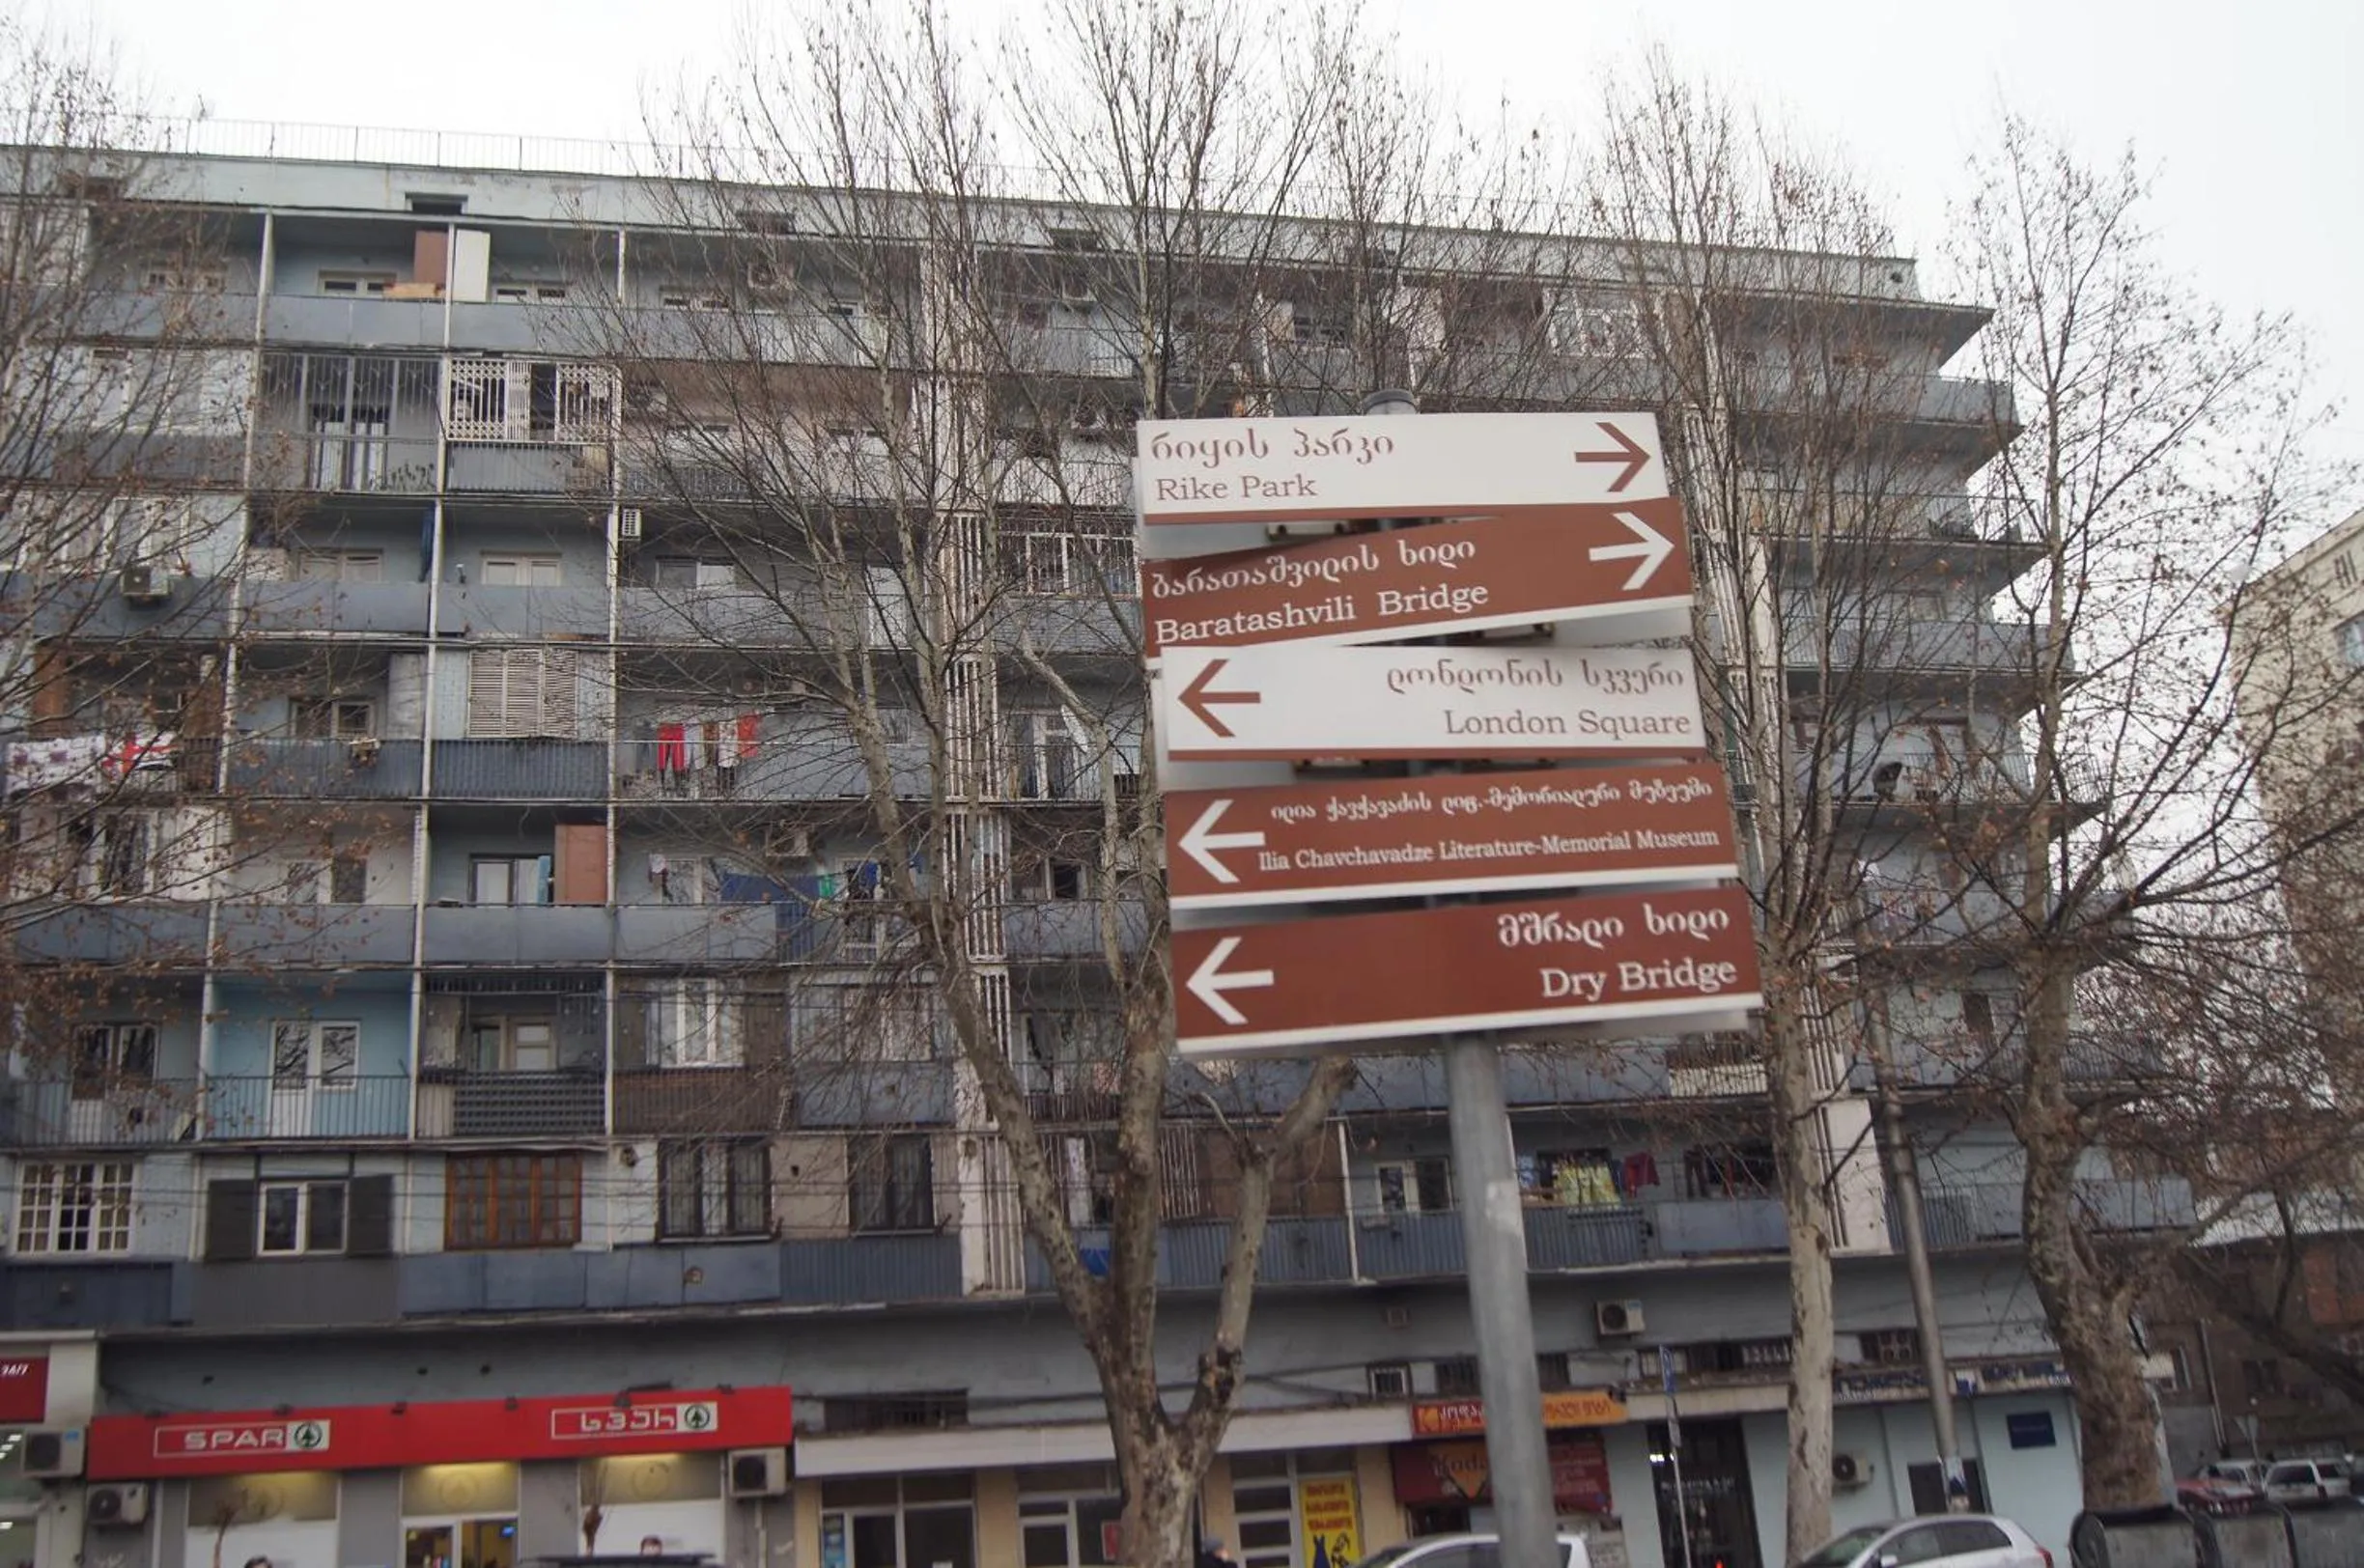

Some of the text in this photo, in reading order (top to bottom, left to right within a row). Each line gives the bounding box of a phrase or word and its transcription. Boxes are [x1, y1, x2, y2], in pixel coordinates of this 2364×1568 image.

[1151, 427, 1393, 468] რიყის პარკი
[1157, 473, 1318, 501] Rike Park
[1152, 539, 1476, 599] ბარათაშვილის ხიდი
[1155, 583, 1489, 644] Baratashvili Bridge
[1388, 658, 1683, 694] ლონდონის სკვერი
[1444, 709, 1690, 741] London Square
[1271, 803, 1316, 825] ილია
[1326, 791, 1432, 822] ჭავჭავაძის
[1628, 776, 1713, 803] მუზეუმი
[1258, 828, 1720, 871] Ilia Chavchavadze Literature-Memorial Museum
[1498, 902, 1730, 950] მშრალი ხიდი
[1539, 956, 1738, 1002] Dry Bridge
[183, 1428, 285, 1450] SPAR
